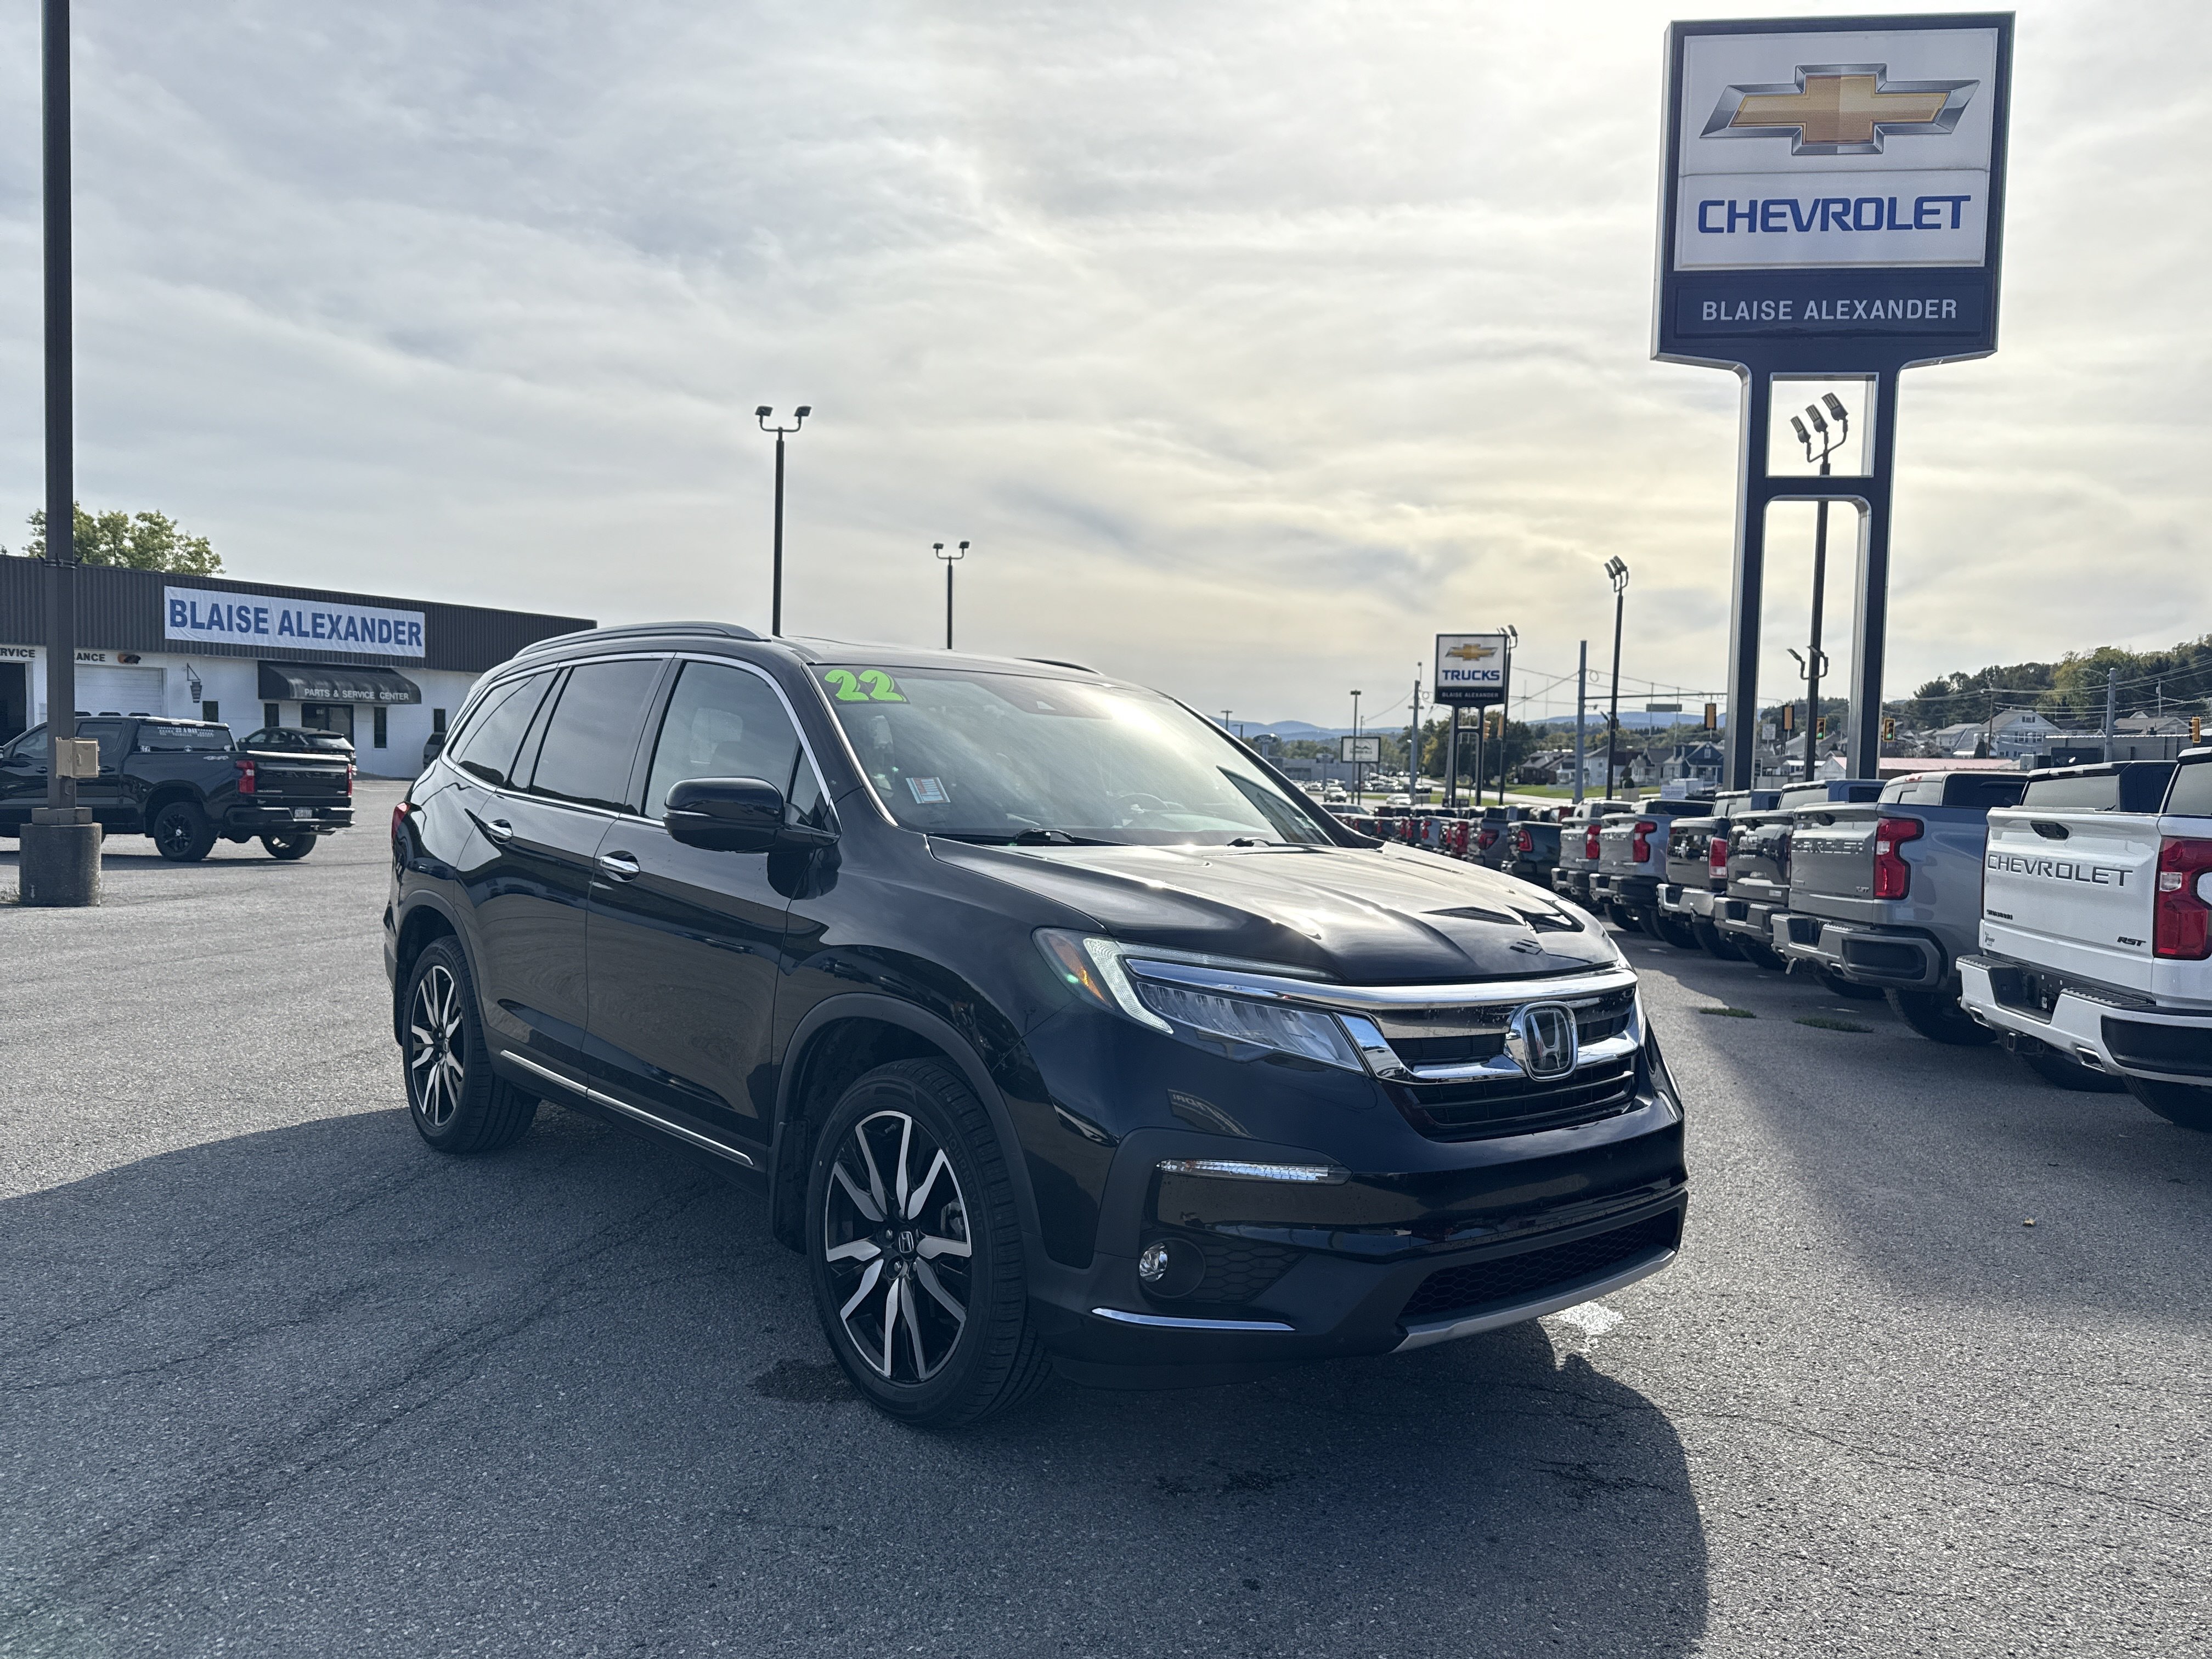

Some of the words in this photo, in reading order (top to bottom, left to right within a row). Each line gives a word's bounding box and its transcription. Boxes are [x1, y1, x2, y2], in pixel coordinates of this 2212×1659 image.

[1697, 195, 1971, 233] CHEVROLET
[1702, 301, 1792, 320] BLAISE
[1803, 298, 1957, 320] ALEXANDER
[170, 599, 269, 634] BLAISE
[278, 610, 422, 647] ALEXANDER
[0, 647, 36, 658] RVICE
[75, 652, 106, 662] ANCE
[824, 669, 907, 702] 22
[1442, 670, 1500, 680] TRUCKS
[304, 688, 330, 697] PARTS
[342, 690, 375, 699] SERVICE
[380, 691, 409, 700] CENTER
[1987, 854, 2134, 887] CHEVROLET
[2117, 936, 2147, 946] RST
